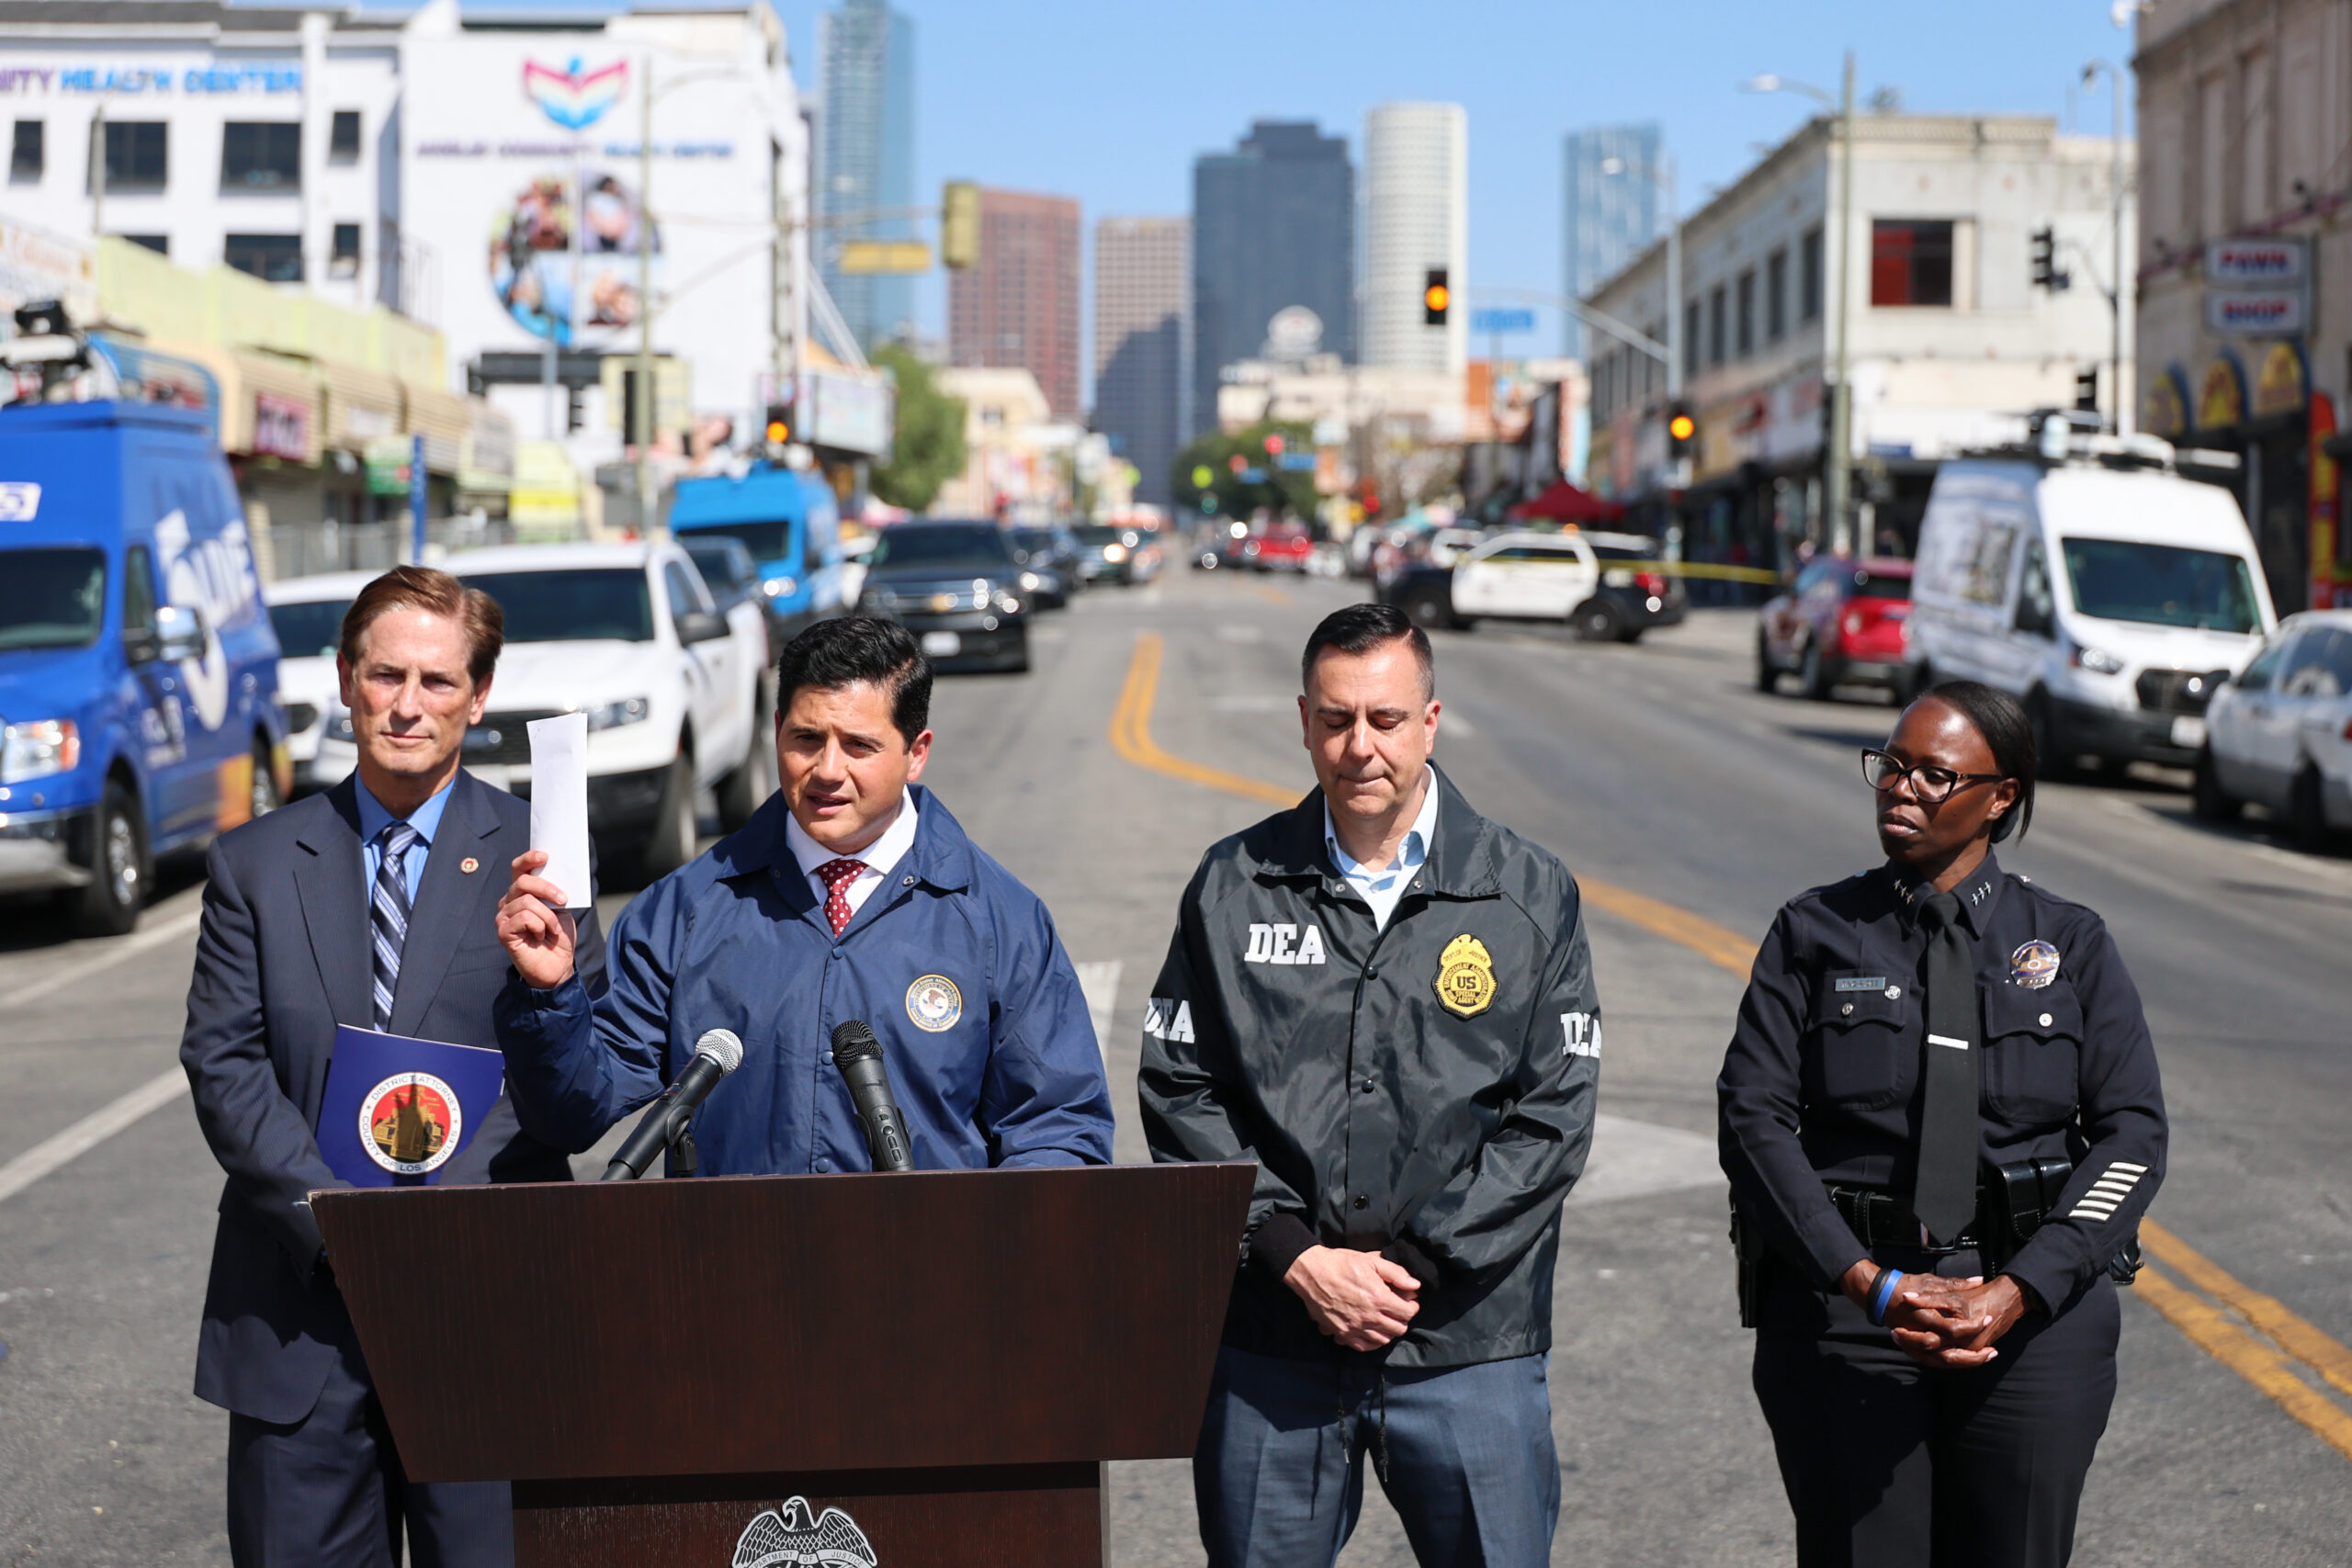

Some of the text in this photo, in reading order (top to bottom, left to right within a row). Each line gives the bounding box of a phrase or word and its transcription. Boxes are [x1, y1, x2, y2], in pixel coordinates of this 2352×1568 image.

[2221, 251, 2288, 272] PAWN
[2223, 300, 2288, 323] SHOP
[1244, 923, 1327, 965] DEA
[1455, 976, 1476, 990] US
[371, 1075, 458, 1111] DISTRICT ATTORNEY
[362, 1115, 458, 1172] COUNTY OF LOS ANGELES
[831, 1551, 863, 1568] JUSTICE
